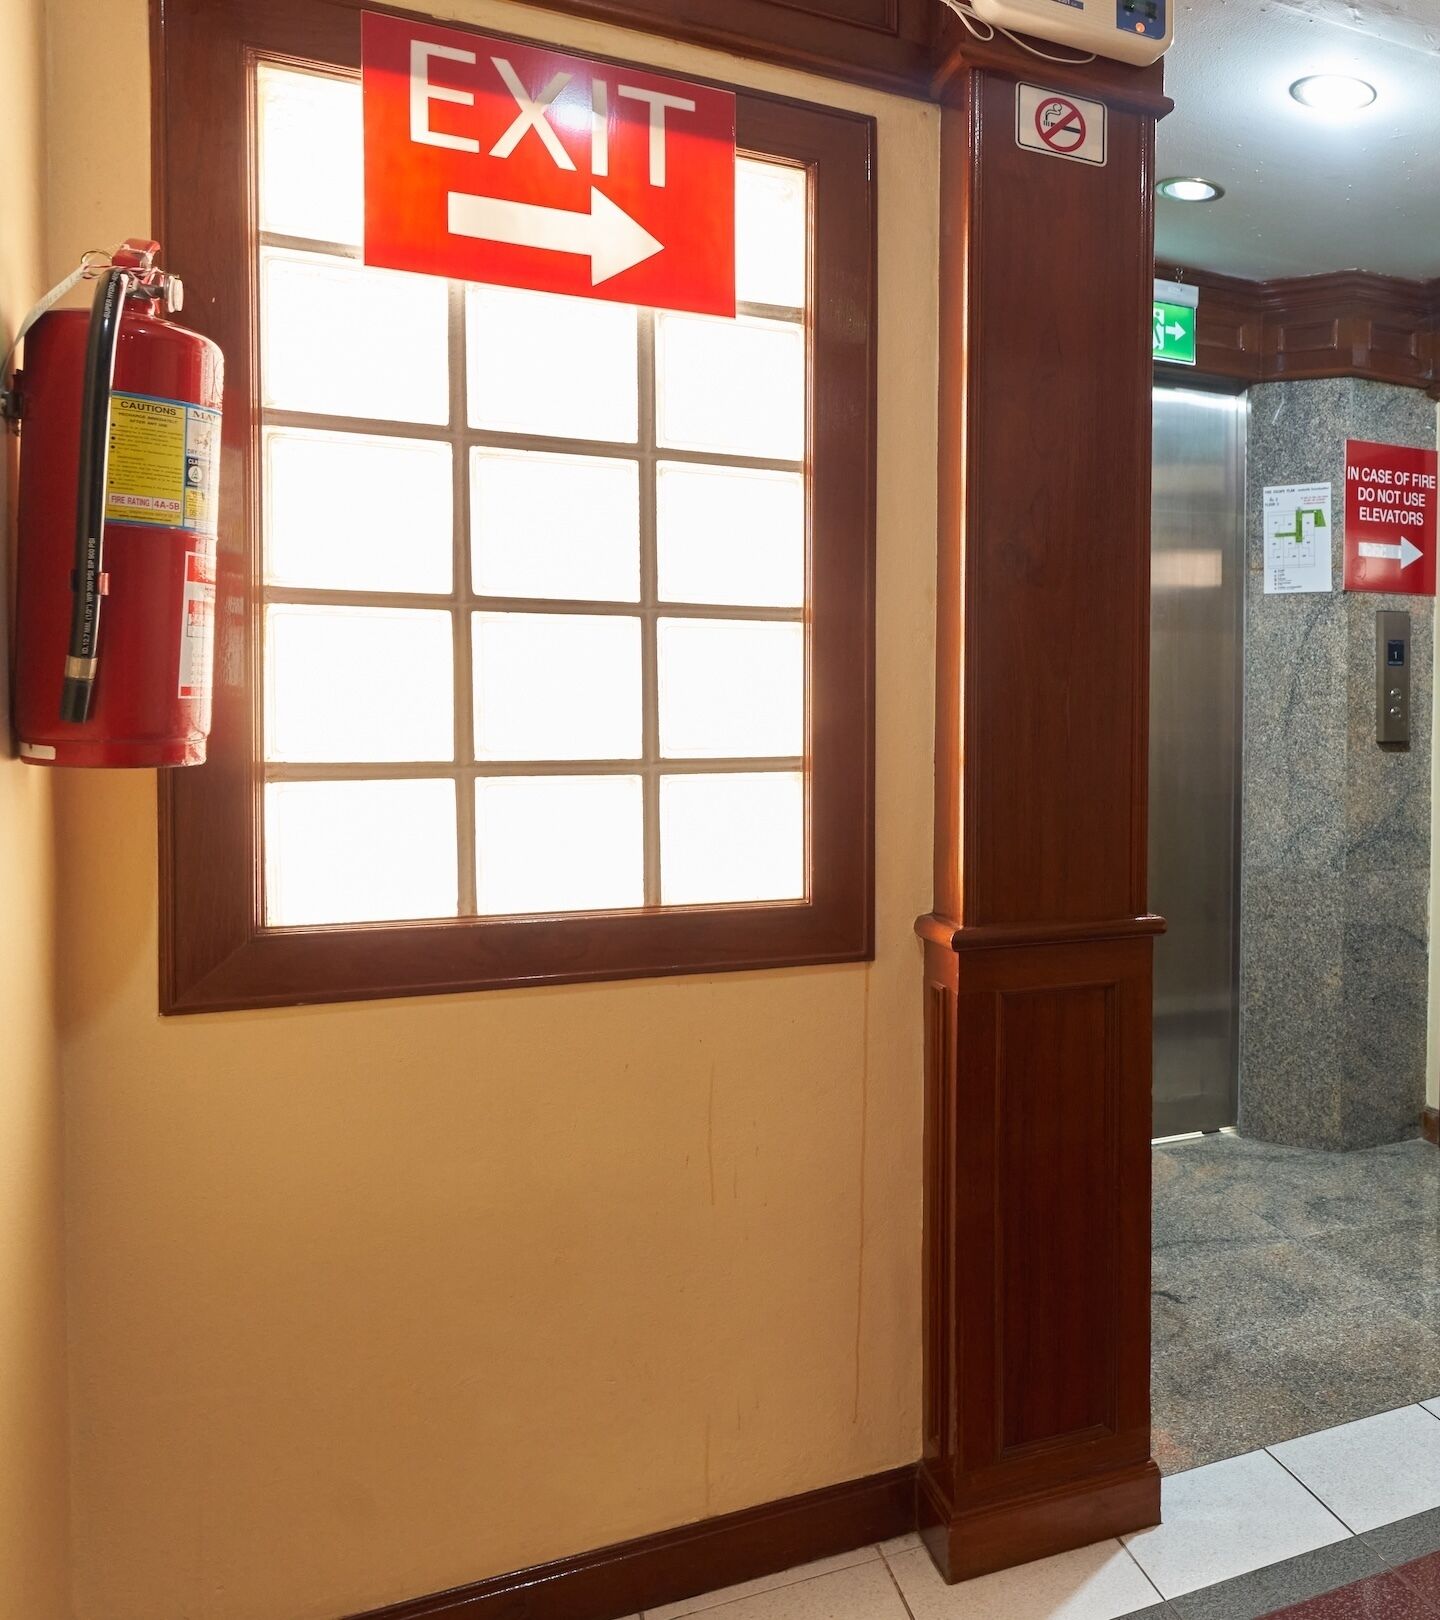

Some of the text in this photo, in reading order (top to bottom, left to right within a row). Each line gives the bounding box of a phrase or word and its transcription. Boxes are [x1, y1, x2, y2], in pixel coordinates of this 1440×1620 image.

[409, 39, 696, 189] EXIT
[120, 401, 177, 416] CAUTIONS
[1347, 466, 1436, 490] IN CASE OF FIRE
[110, 495, 180, 511] FIRE RATING 4A-5B
[1357, 486, 1426, 508] DO NOT USE
[1359, 506, 1425, 527] ELEVATORS
